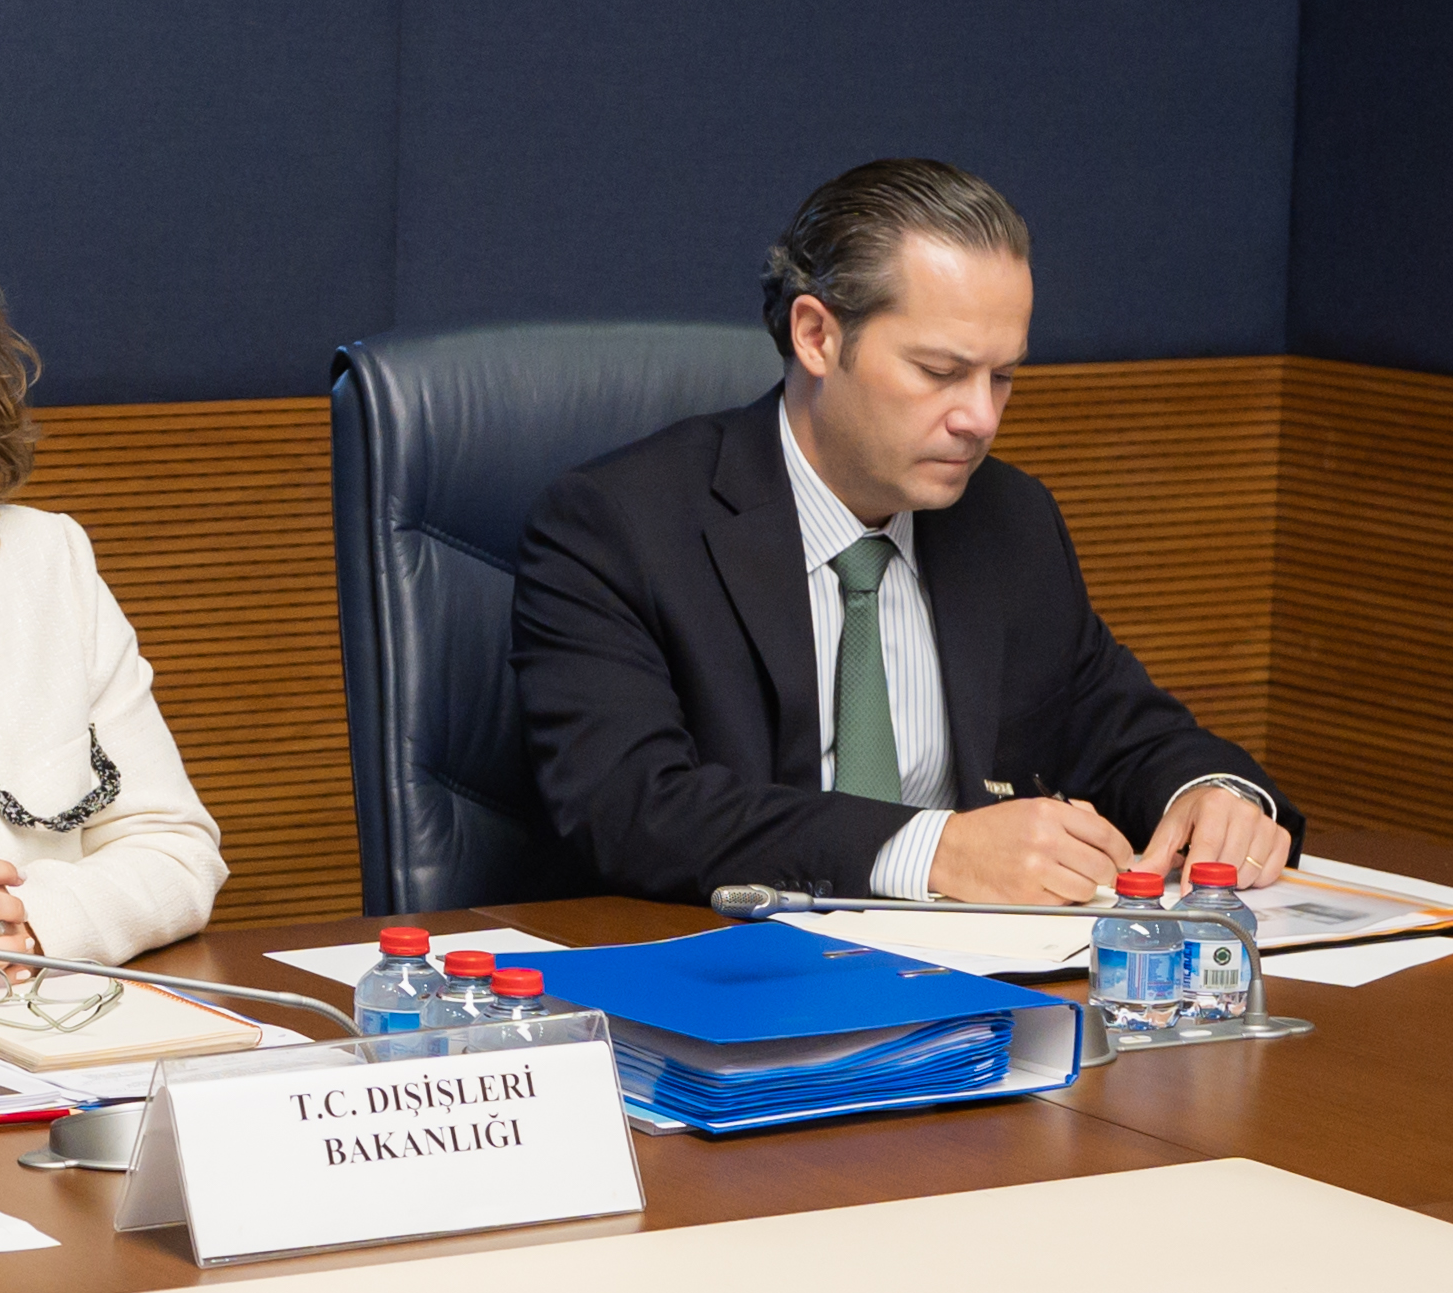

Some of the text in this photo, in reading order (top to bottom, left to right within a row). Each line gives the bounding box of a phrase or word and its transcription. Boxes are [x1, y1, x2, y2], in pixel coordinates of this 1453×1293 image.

[290, 1063, 538, 1121] T.C. DIŞİŞLERİ
[323, 1113, 524, 1167] BAKANLIĞI
